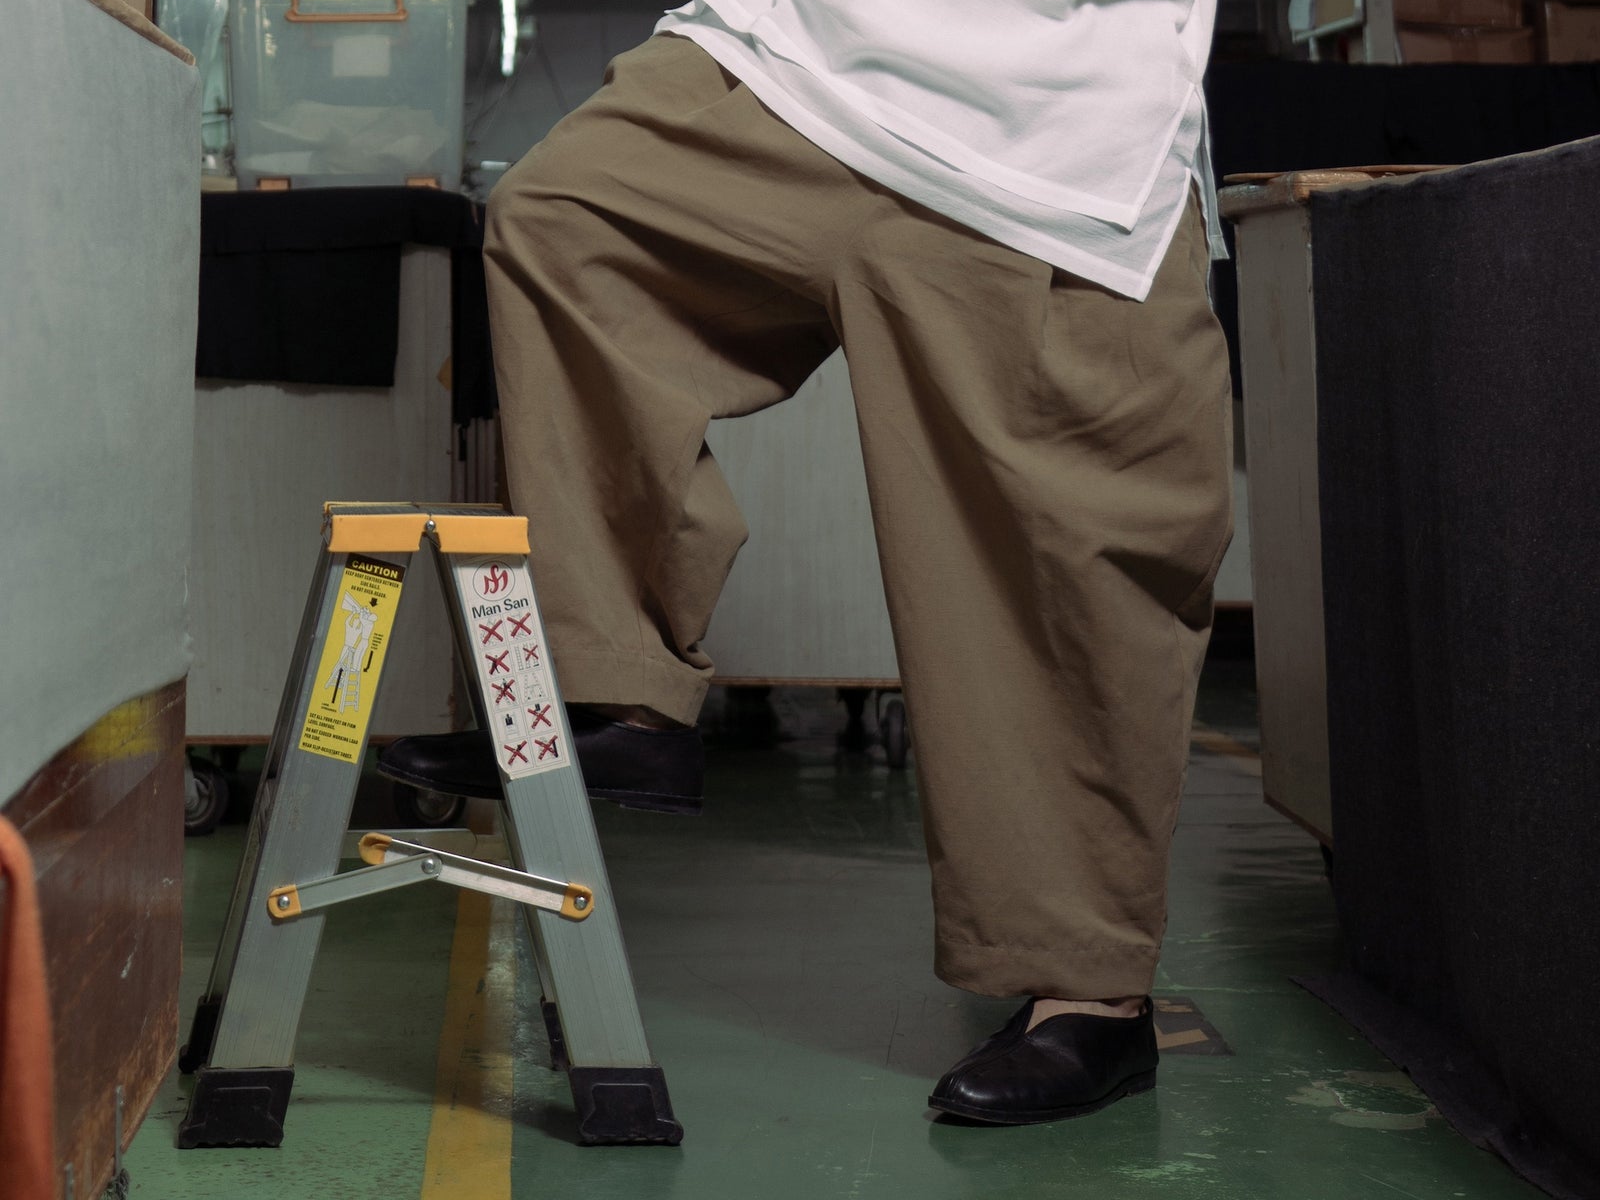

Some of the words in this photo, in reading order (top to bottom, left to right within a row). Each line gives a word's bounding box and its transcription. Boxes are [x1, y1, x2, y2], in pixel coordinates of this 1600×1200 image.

[352, 560, 398, 579] CAUTION
[471, 604, 502, 619] Man
[503, 597, 529, 611] San
[333, 734, 349, 742] WORKING
